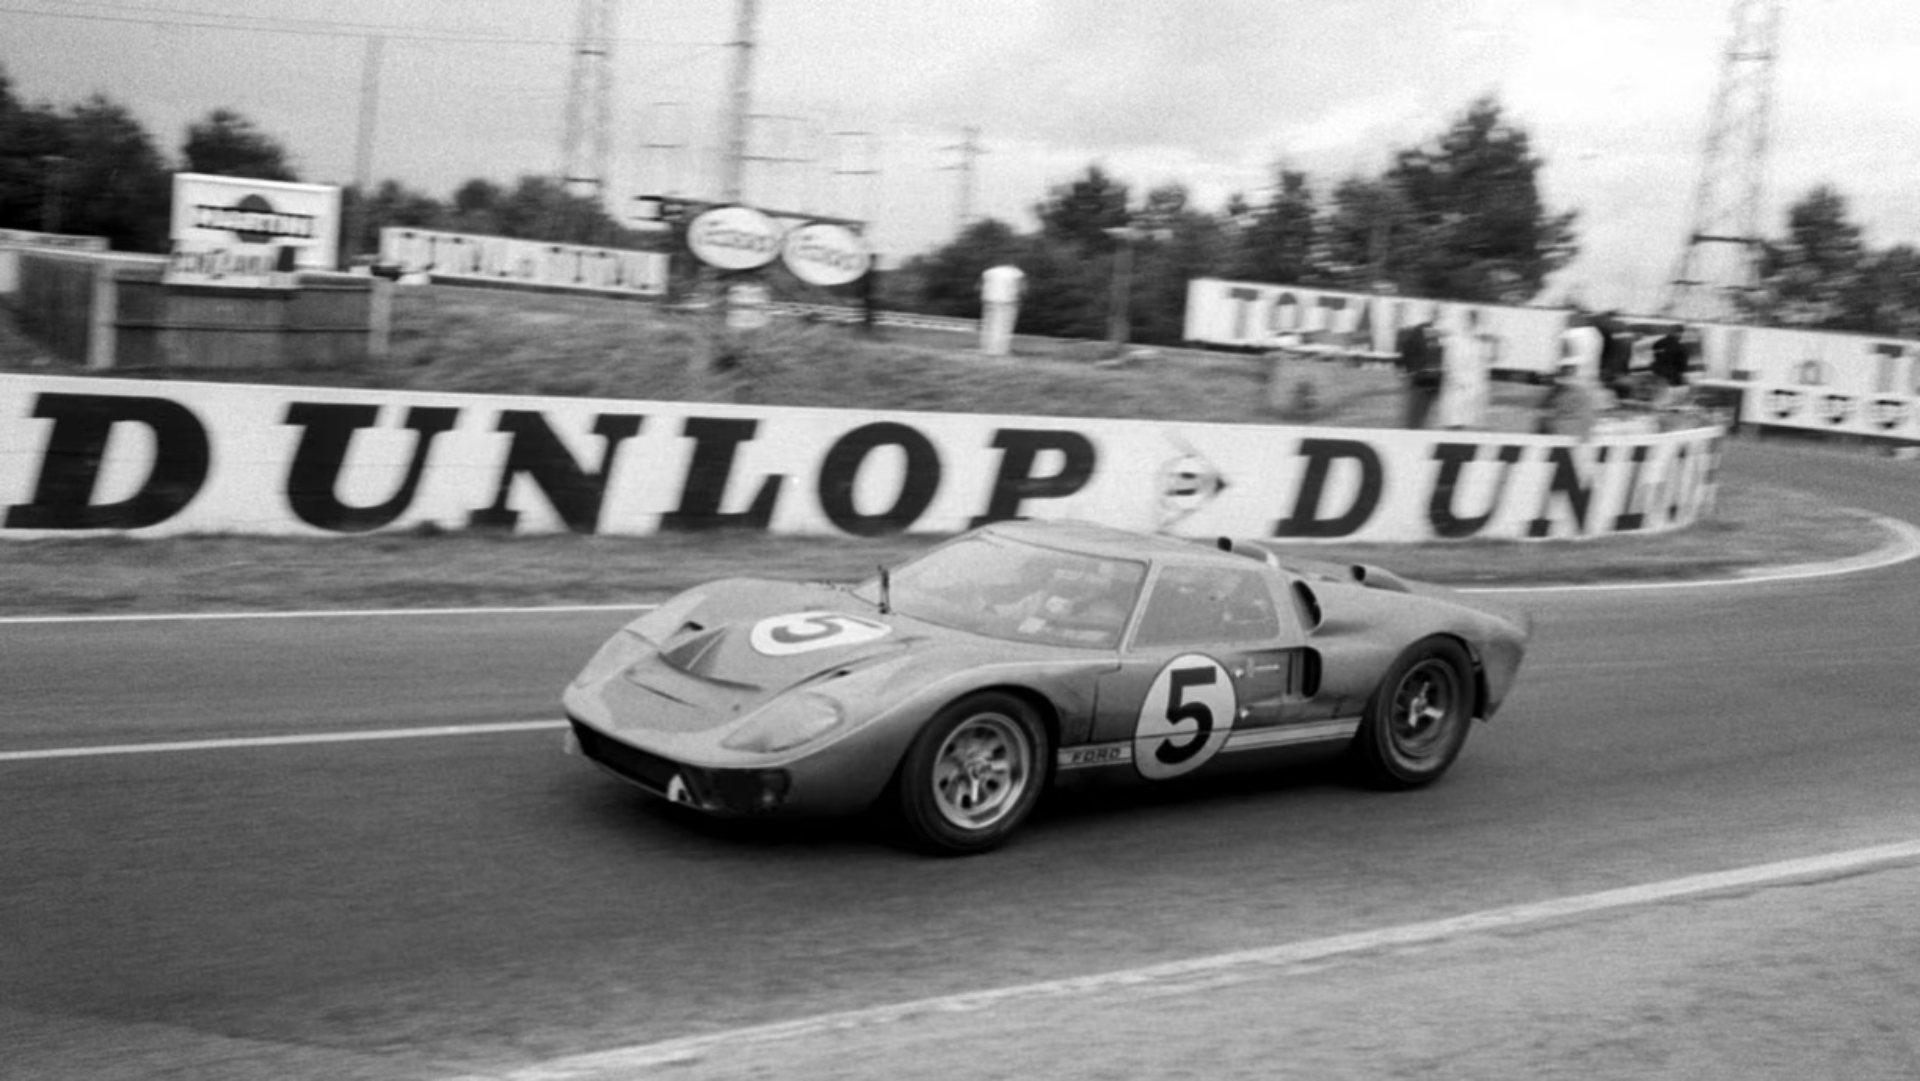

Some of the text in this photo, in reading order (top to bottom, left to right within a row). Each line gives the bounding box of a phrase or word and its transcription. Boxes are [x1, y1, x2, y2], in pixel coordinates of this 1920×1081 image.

[4, 392, 1097, 537] DUNLOP
[770, 614, 882, 644] 5
[1155, 667, 1217, 765] 5
[1071, 748, 1121, 763] FORD
